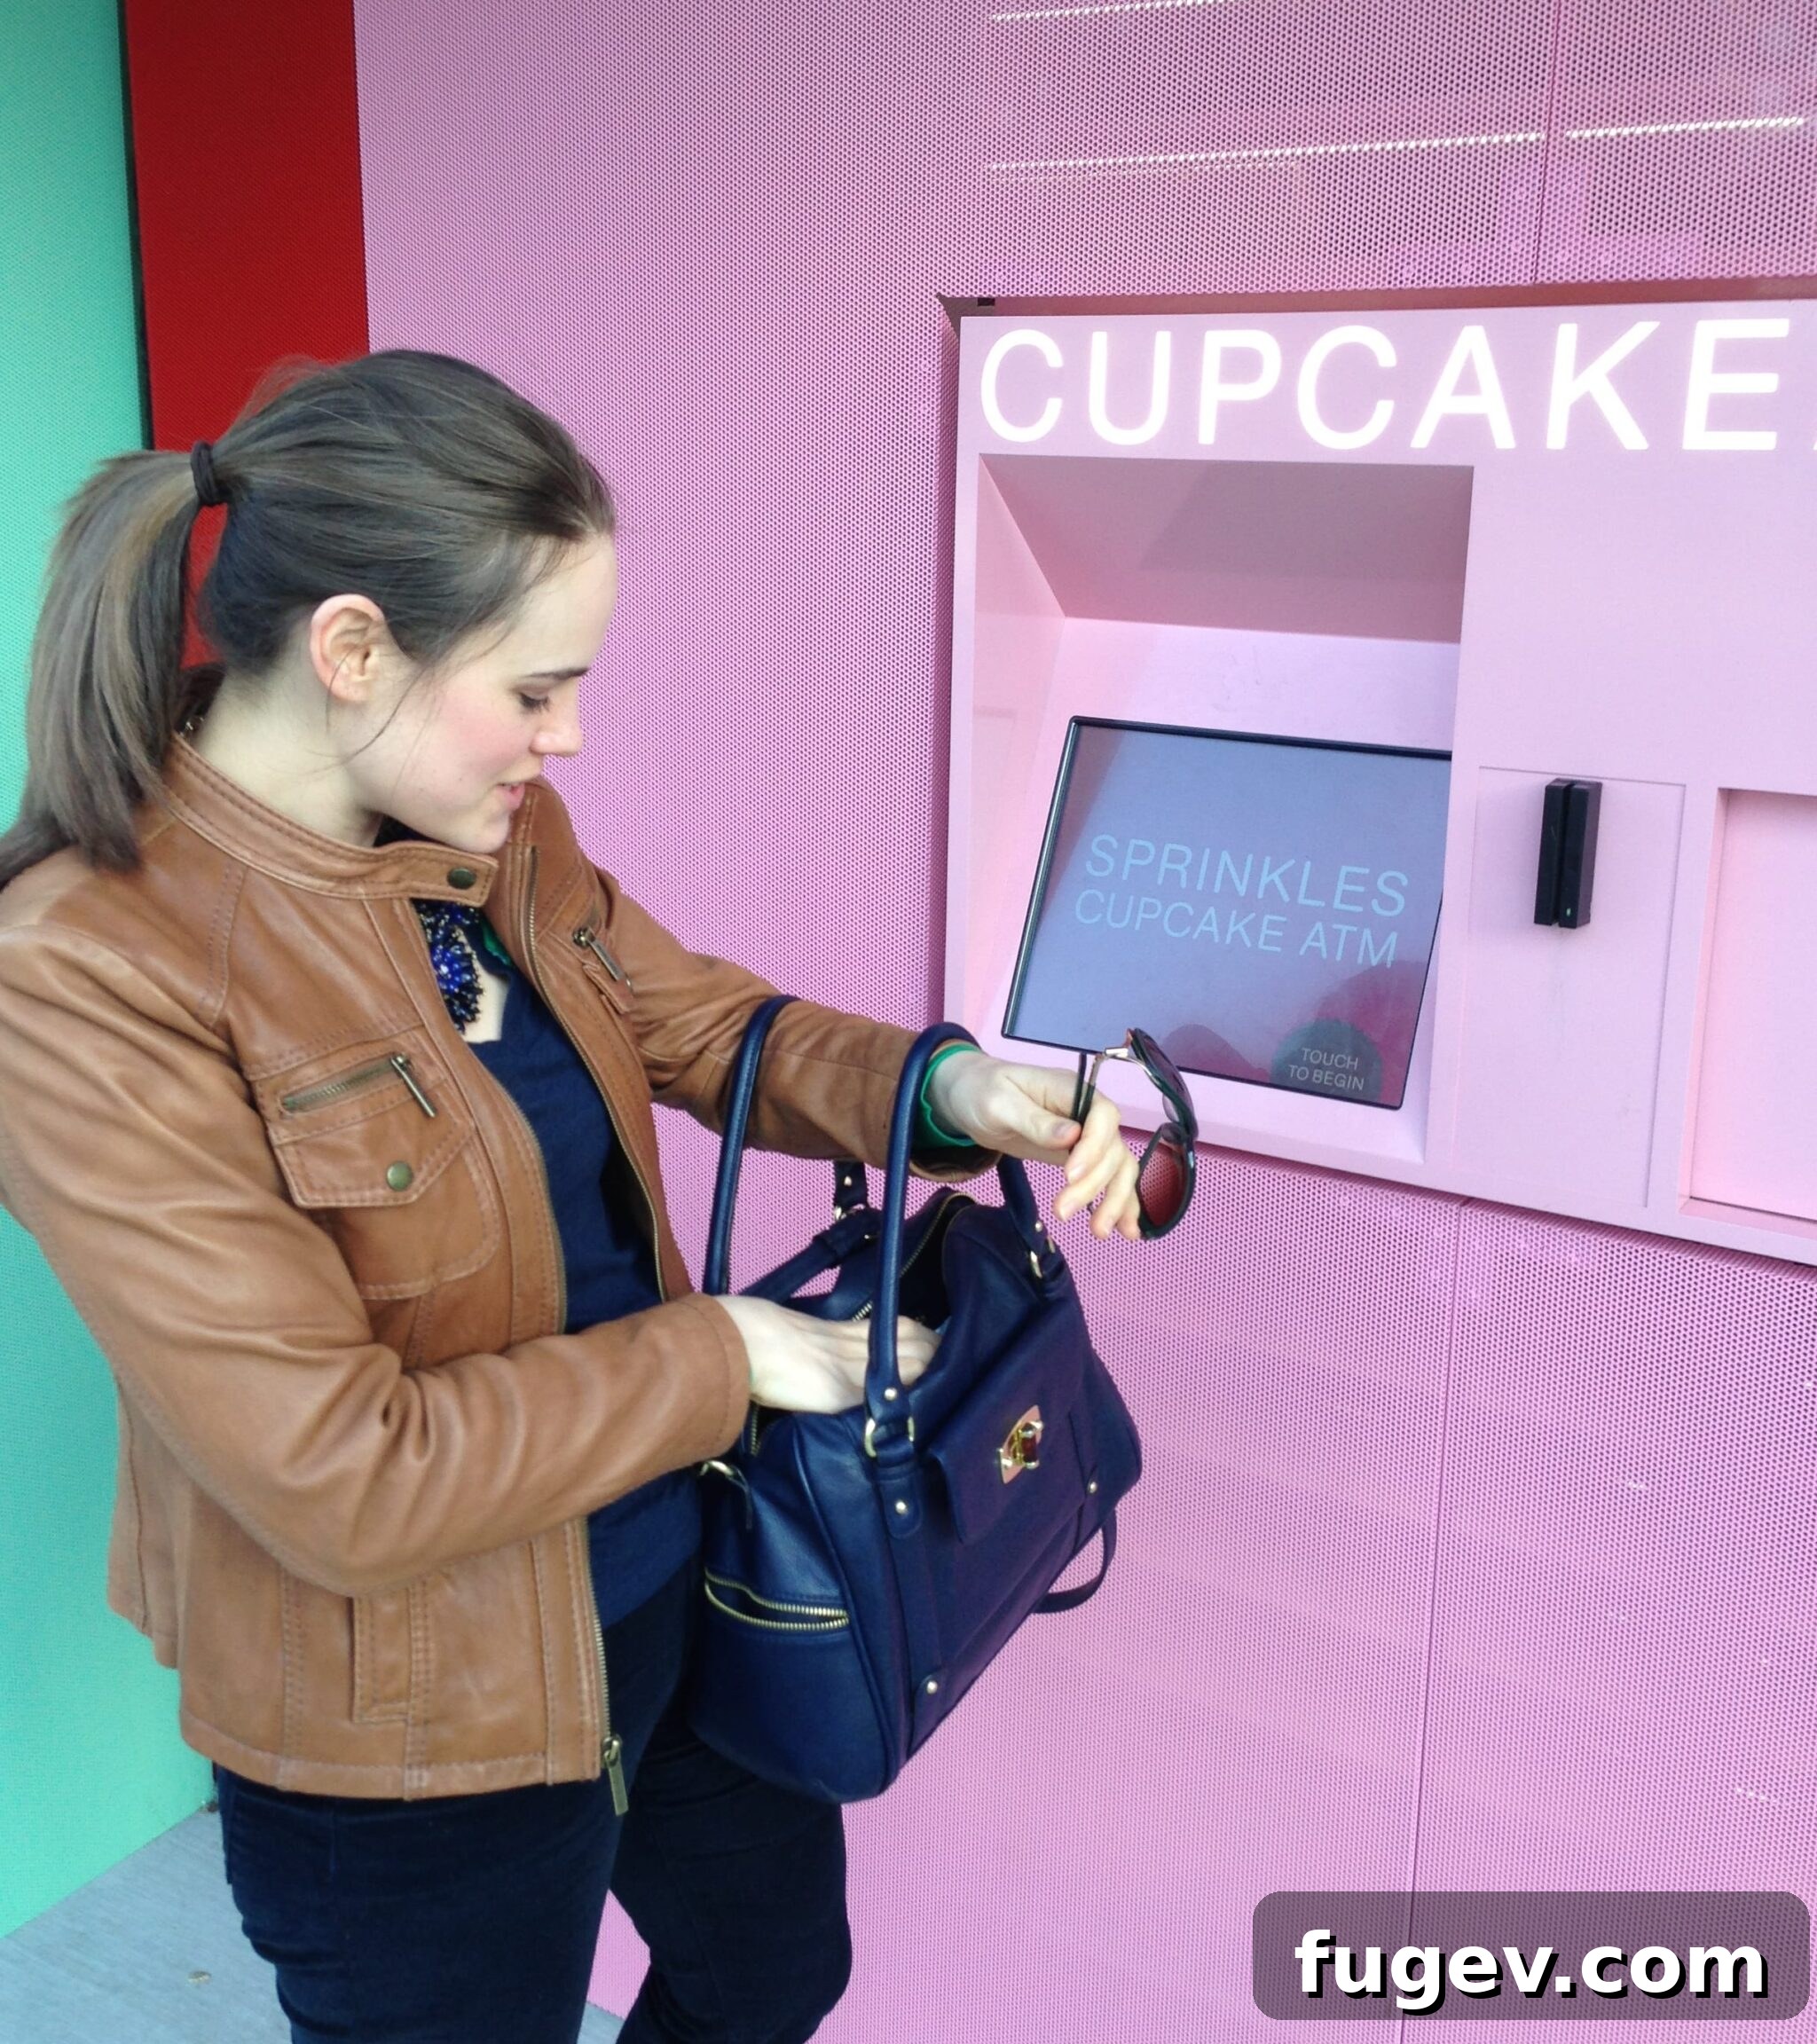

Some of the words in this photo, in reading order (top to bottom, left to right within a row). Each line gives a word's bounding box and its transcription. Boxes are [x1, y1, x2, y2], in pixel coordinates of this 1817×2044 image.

[978, 318, 1790, 451] CUPCAKE
[1085, 834, 1408, 917] SPRINKLES
[1075, 889, 1287, 953] CUPCAKE
[1299, 922, 1398, 968] ATM
[1288, 1065, 1310, 1081] TO
[1312, 1069, 1365, 1090] BEGIN
[1301, 1048, 1358, 1071] TOUCH
